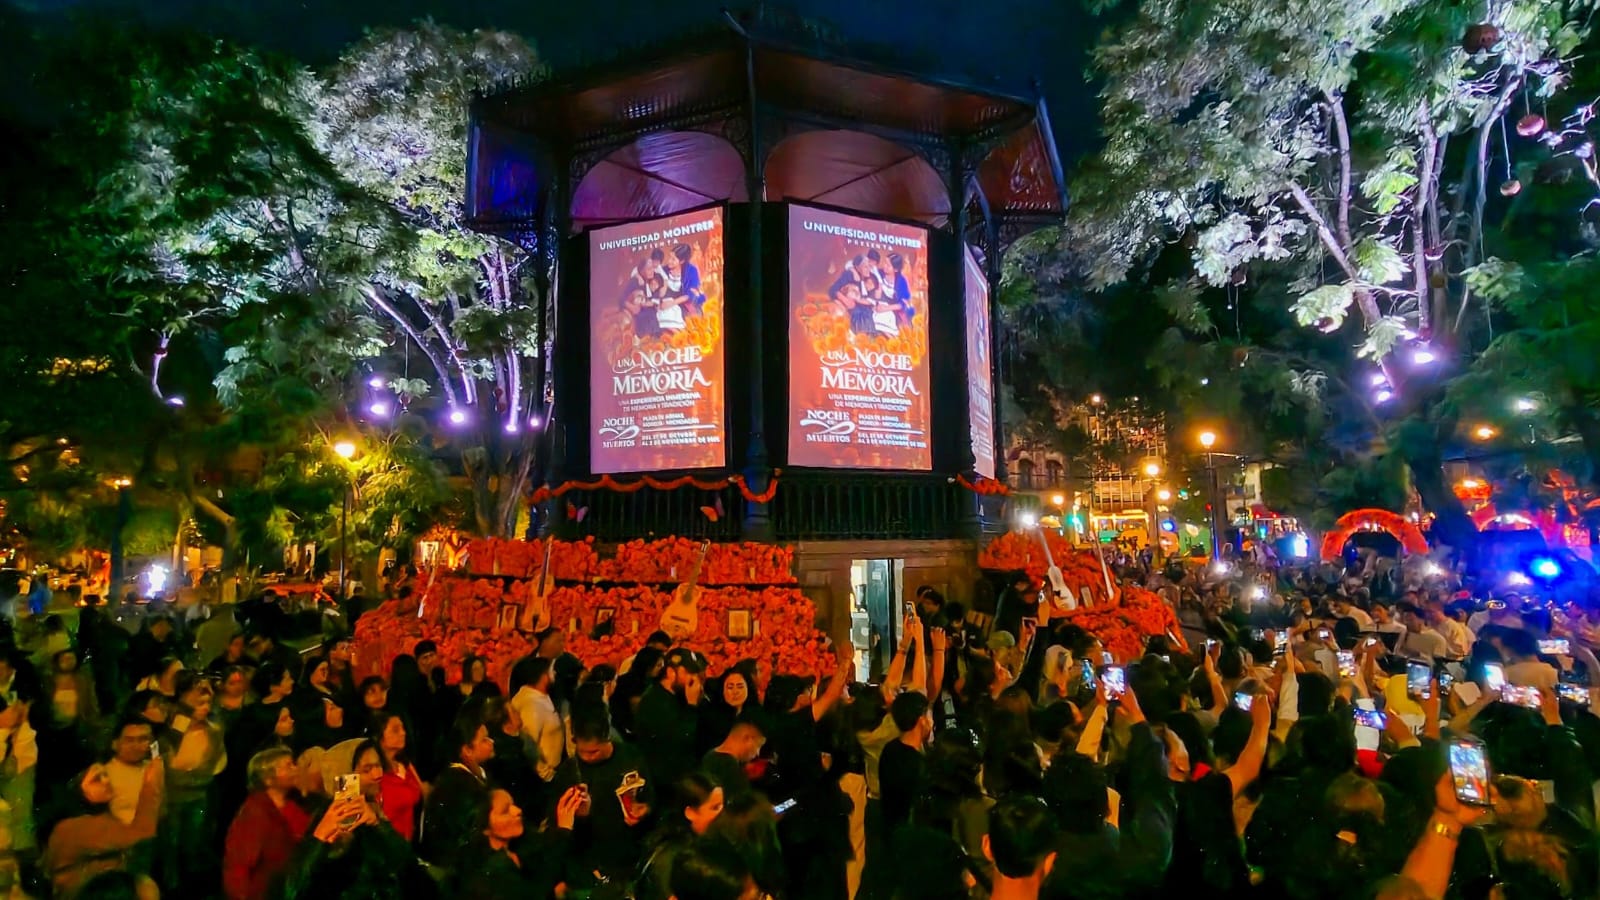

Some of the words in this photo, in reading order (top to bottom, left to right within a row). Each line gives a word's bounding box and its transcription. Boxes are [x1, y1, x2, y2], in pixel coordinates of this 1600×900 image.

[600, 232, 660, 250] UNIVERSIDAD
[803, 220, 877, 241] UNIVERSIDAD
[617, 358, 636, 369] UNA
[639, 345, 703, 369] NOCHE
[827, 351, 851, 362] UNA
[854, 347, 913, 371] NOCHE
[613, 367, 713, 397] MEMORIA
[820, 366, 921, 398] MEMORIA
[604, 416, 635, 428] NOCHE
[807, 409, 850, 421] NOCHE
